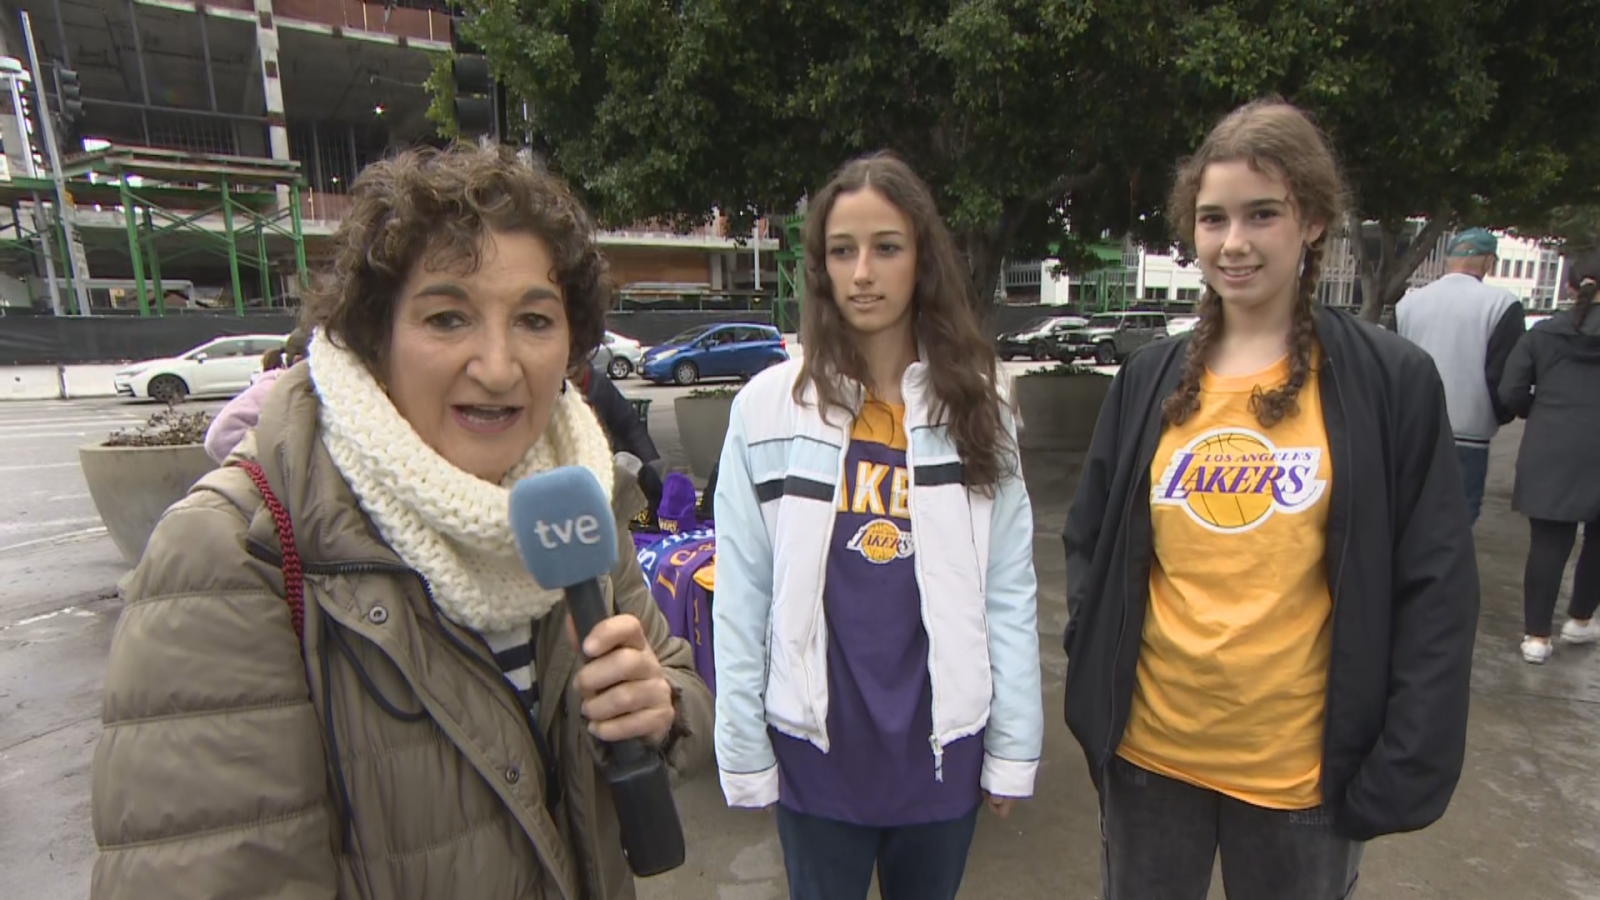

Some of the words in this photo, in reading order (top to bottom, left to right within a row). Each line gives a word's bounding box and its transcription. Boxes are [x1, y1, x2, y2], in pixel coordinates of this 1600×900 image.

[1204, 453, 1232, 463] LOS
[1234, 451, 1313, 463] ANGELES
[1158, 452, 1317, 507] LAKERS
[534, 514, 601, 550] tve
[853, 529, 909, 555] LAKERS
